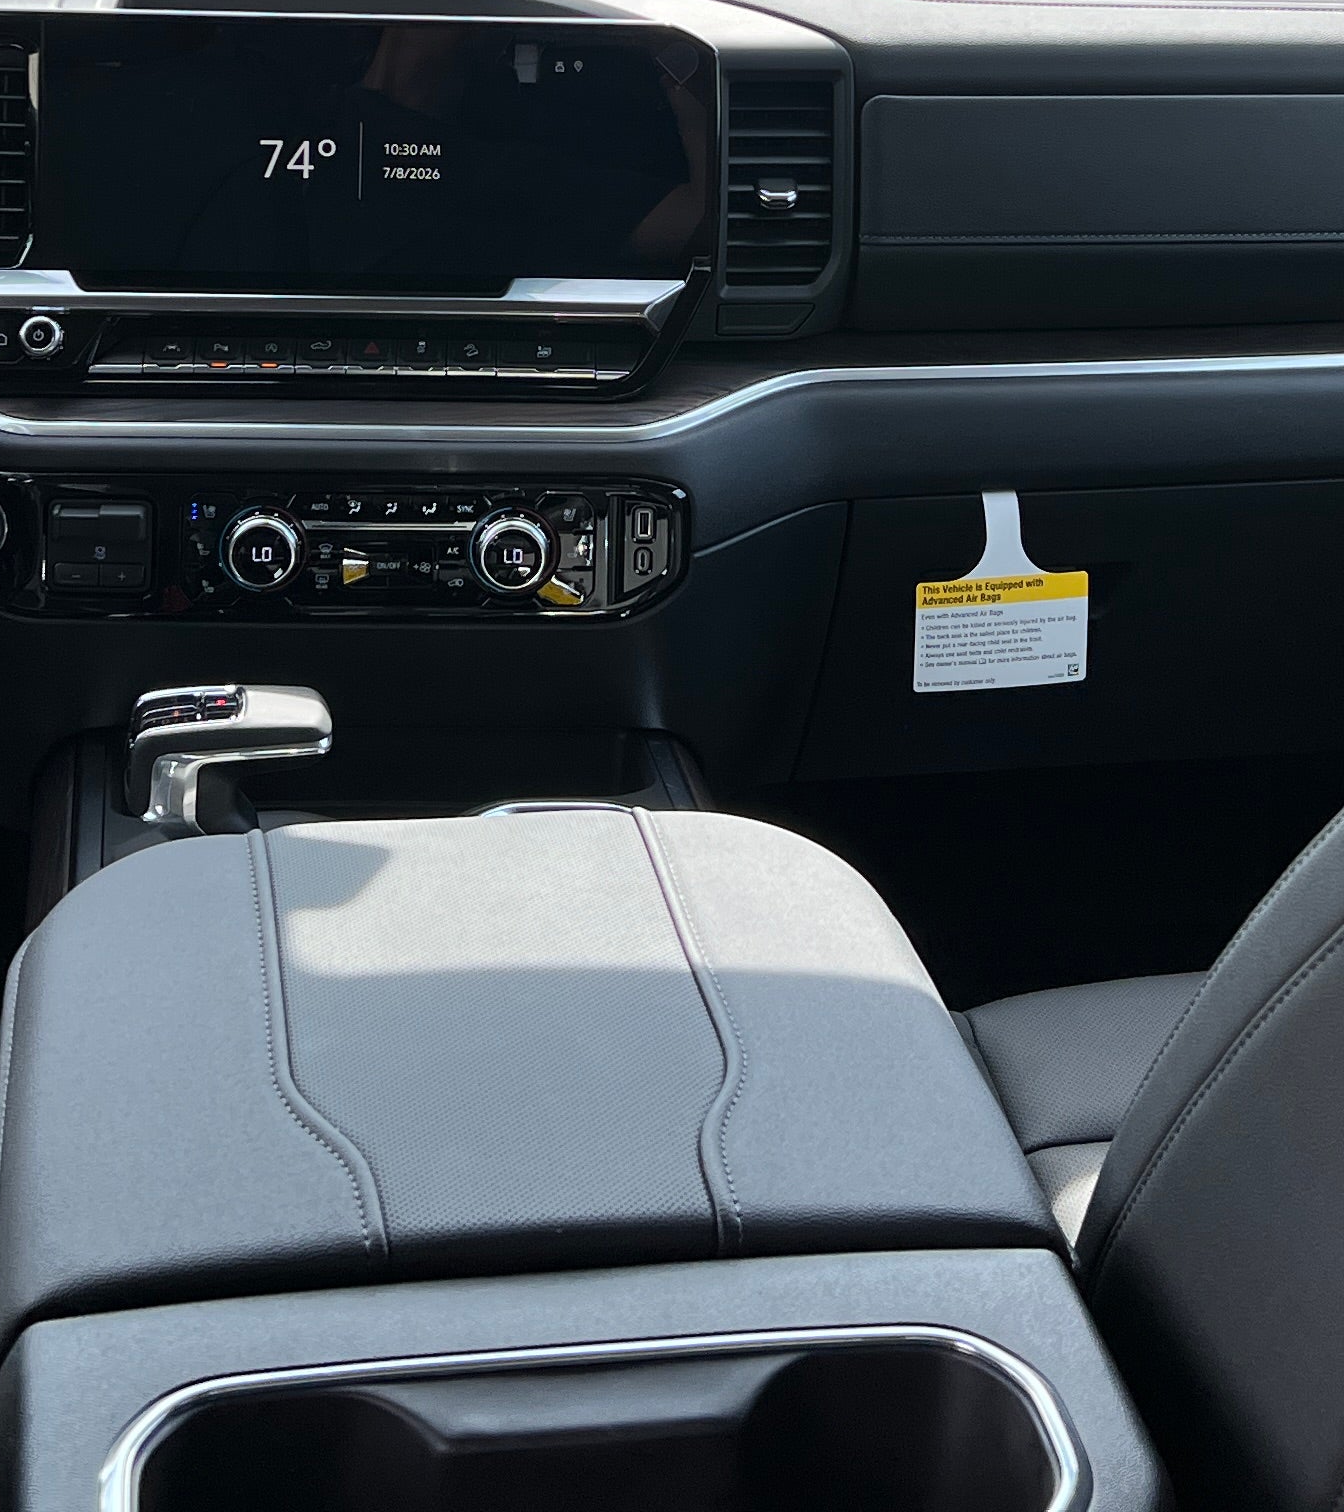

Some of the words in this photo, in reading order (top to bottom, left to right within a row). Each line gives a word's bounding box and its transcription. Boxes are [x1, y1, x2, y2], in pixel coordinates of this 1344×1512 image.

[384, 144, 417, 156] 10:30
[419, 144, 441, 156] AM
[259, 139, 336, 179] 74°
[383, 167, 441, 180] 7/8/2026
[311, 503, 329, 511] AUTO
[457, 504, 474, 514] SYNC
[252, 546, 272, 562] LO
[447, 546, 459, 555] A/C
[503, 547, 523, 564] LO
[376, 561, 401, 570] ON/OFF
[922, 585, 941, 594] This
[942, 583, 973, 594] Vehicle
[985, 579, 1023, 592] Equipped
[1025, 578, 1044, 587] with
[922, 595, 964, 606] Advanced
[966, 594, 978, 603] Air
[980, 593, 1001, 603] Bags
